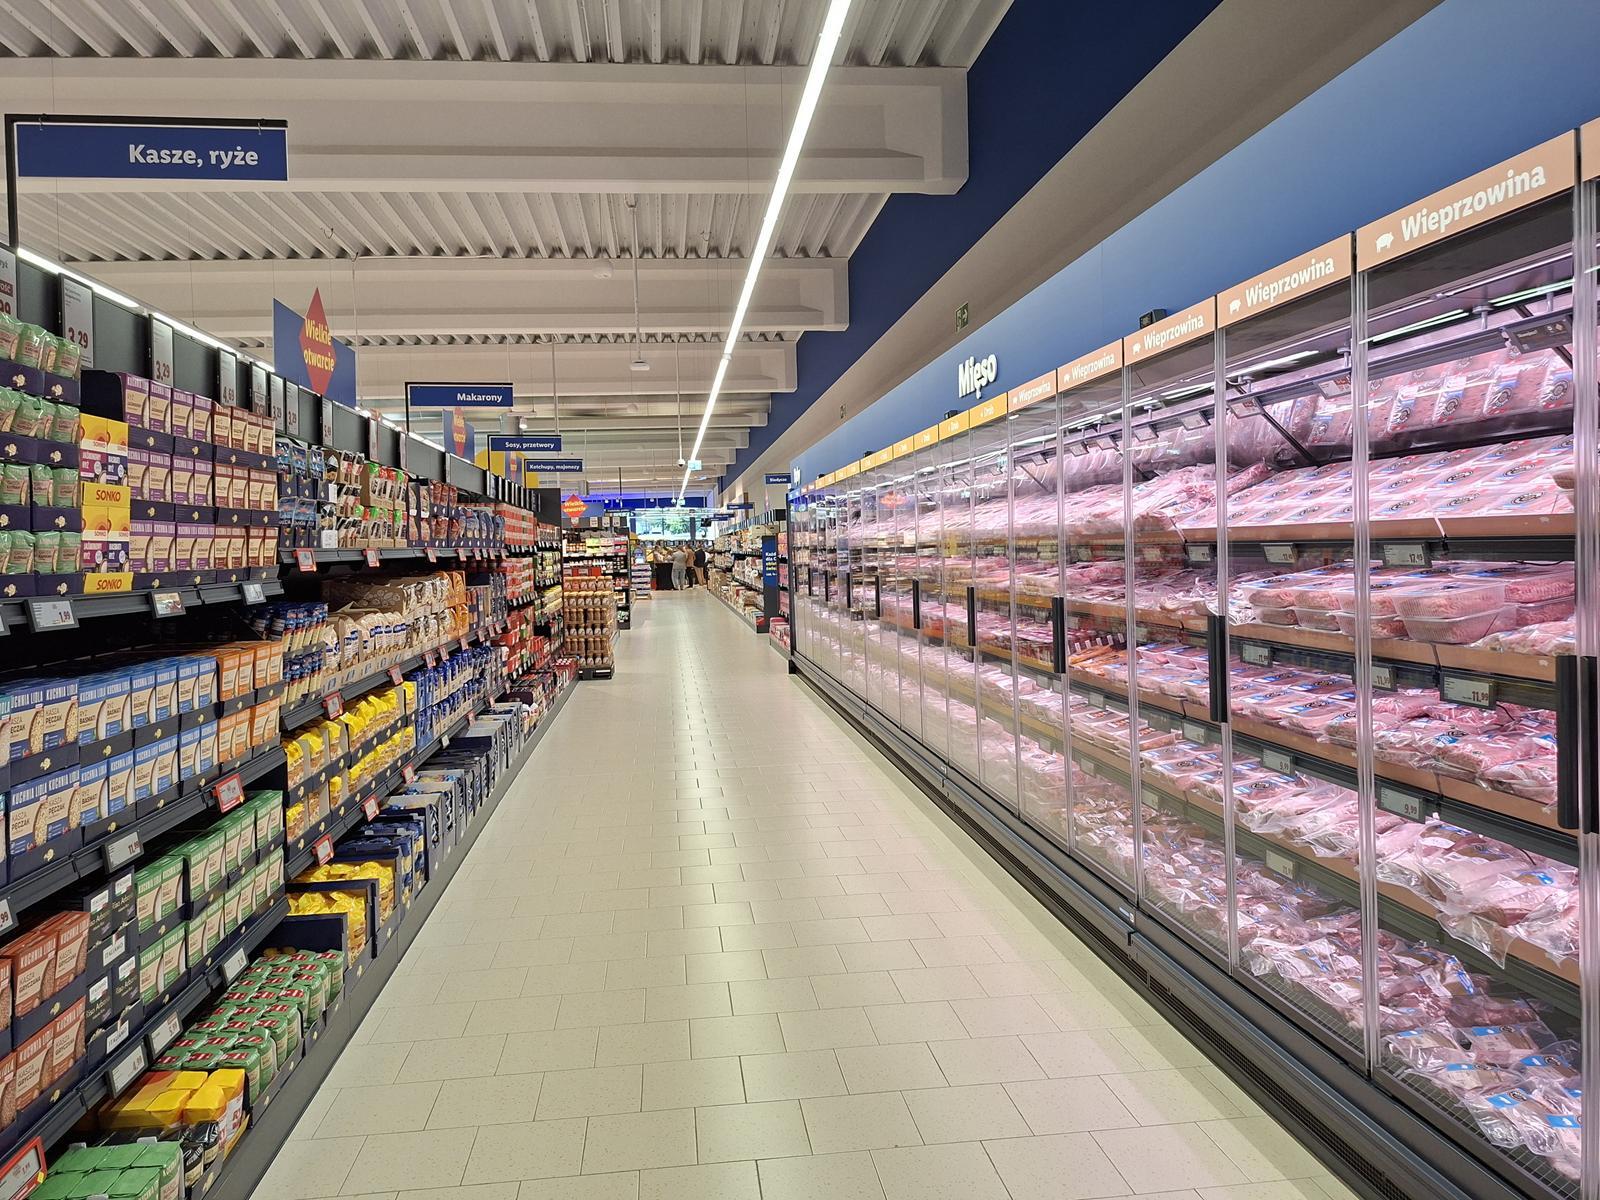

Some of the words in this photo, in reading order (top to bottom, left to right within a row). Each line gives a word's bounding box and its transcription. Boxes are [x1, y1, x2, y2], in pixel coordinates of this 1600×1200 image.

[129, 144, 203, 168] Kasze,
[209, 145, 258, 170] ryże
[1401, 165, 1546, 242] Wieprzowina
[1245, 254, 1335, 308] Wieprzowina
[305, 319, 332, 346] Wielkie
[1144, 314, 1204, 350] Wieprzowina
[303, 348, 335, 372] otwarcie
[1071, 352, 1115, 380] Wieprzowina
[958, 353, 998, 400] Mięso
[456, 392, 503, 404] Makarony
[505, 441, 522, 449] Sosy,
[523, 441, 555, 450] przetwory
[95, 489, 121, 502] SONKO
[96, 578, 123, 591] SONKO
[46, 686, 66, 701] KUCHNIA
[1472, 690, 1489, 703] 11.99
[49, 773, 69, 791] KUCHNIA
[12, 787, 35, 806] KUCHNIA
[1403, 802, 1418, 815] 9.99
